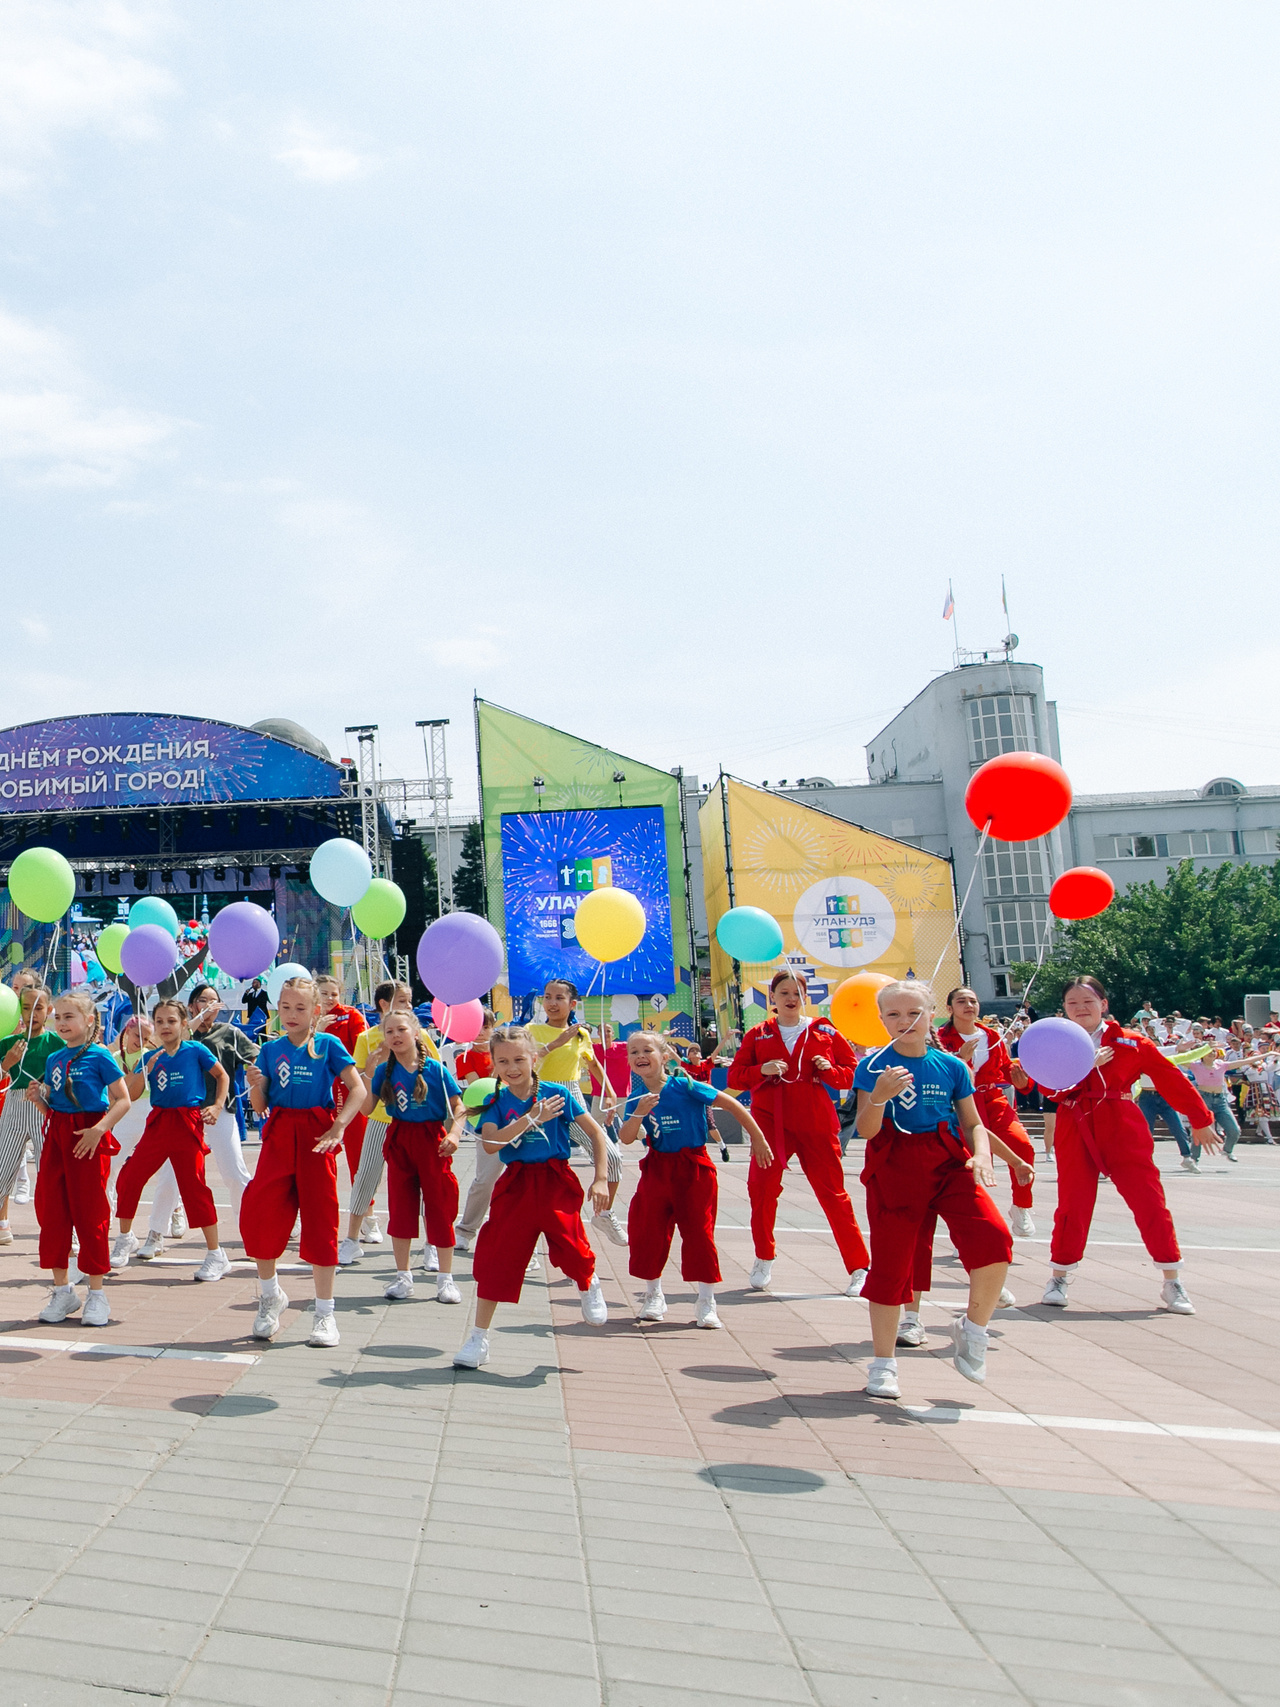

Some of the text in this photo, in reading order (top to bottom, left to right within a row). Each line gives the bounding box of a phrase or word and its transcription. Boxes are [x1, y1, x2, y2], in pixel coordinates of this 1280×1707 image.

[68, 739, 216, 766] РОЖДЕНИЯ,
[115, 769, 206, 791] ГОРОД!
[813, 916, 876, 926] УЛАН-УДЭ
